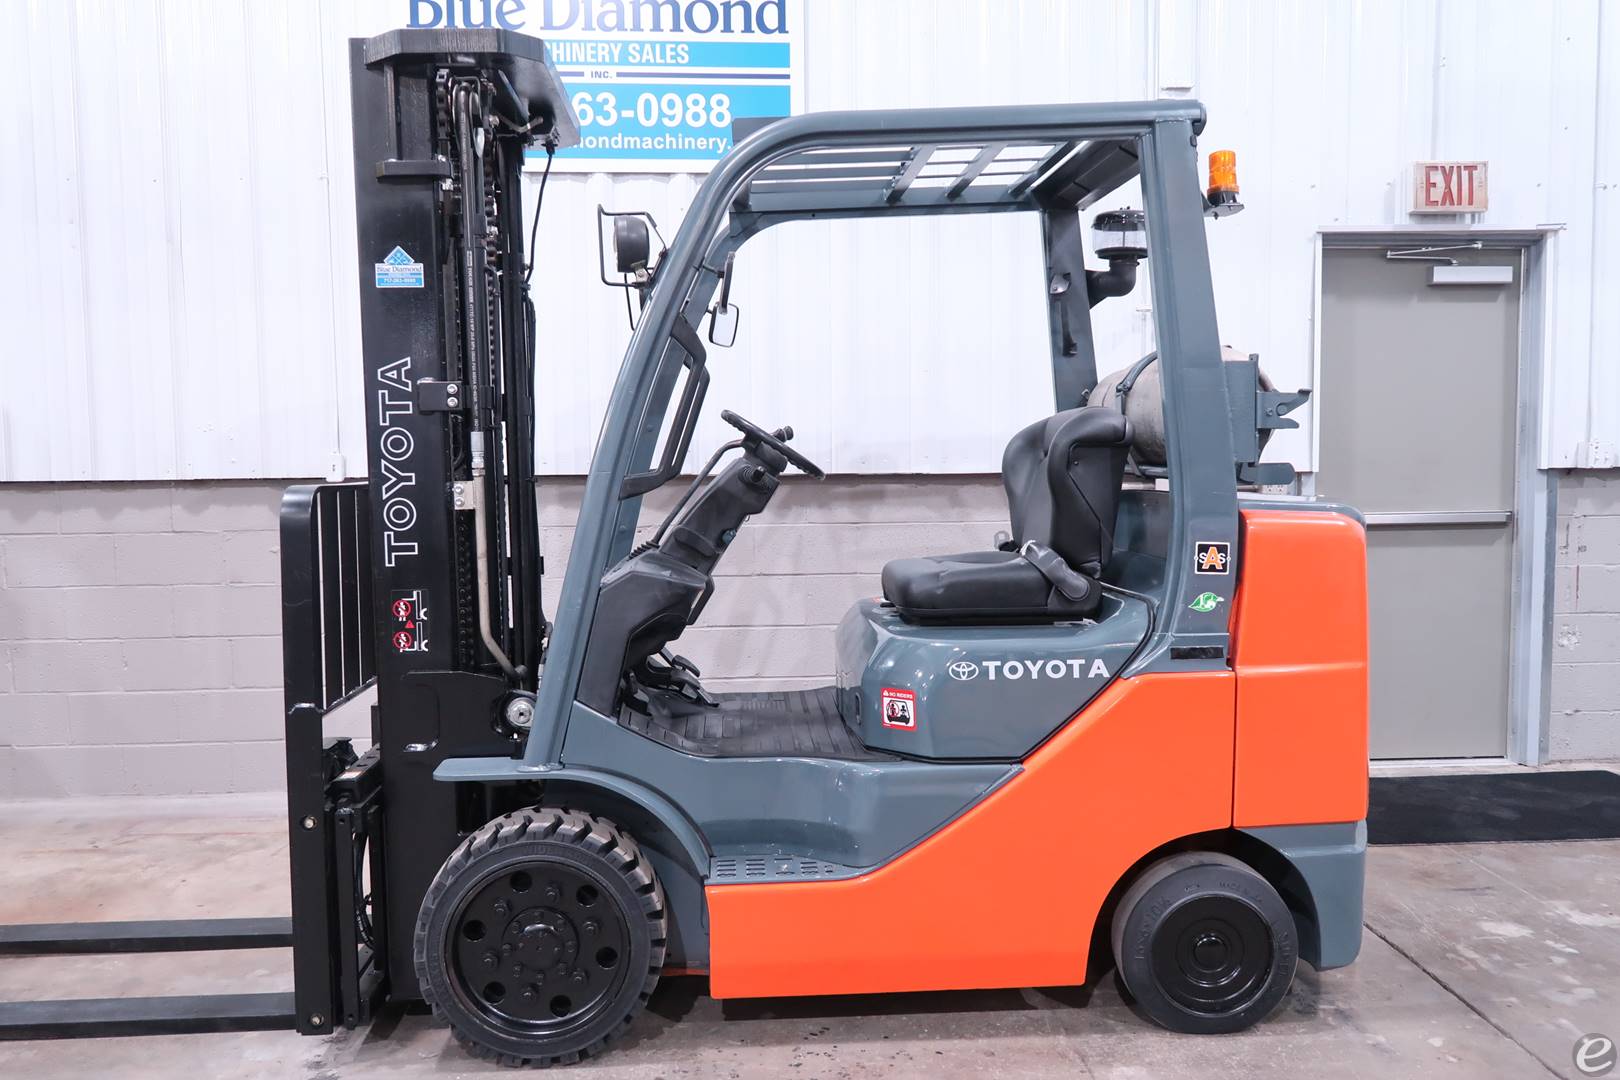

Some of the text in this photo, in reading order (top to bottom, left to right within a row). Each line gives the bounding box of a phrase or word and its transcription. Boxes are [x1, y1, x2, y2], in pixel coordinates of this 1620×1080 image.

[406, 0, 789, 34] Blue Diamond
[628, 43, 689, 65] SALES
[590, 70, 613, 79] INC.
[1425, 165, 1478, 206] EXIT
[378, 357, 419, 567] TOYOTA
[982, 659, 1111, 681] TOYOTA
